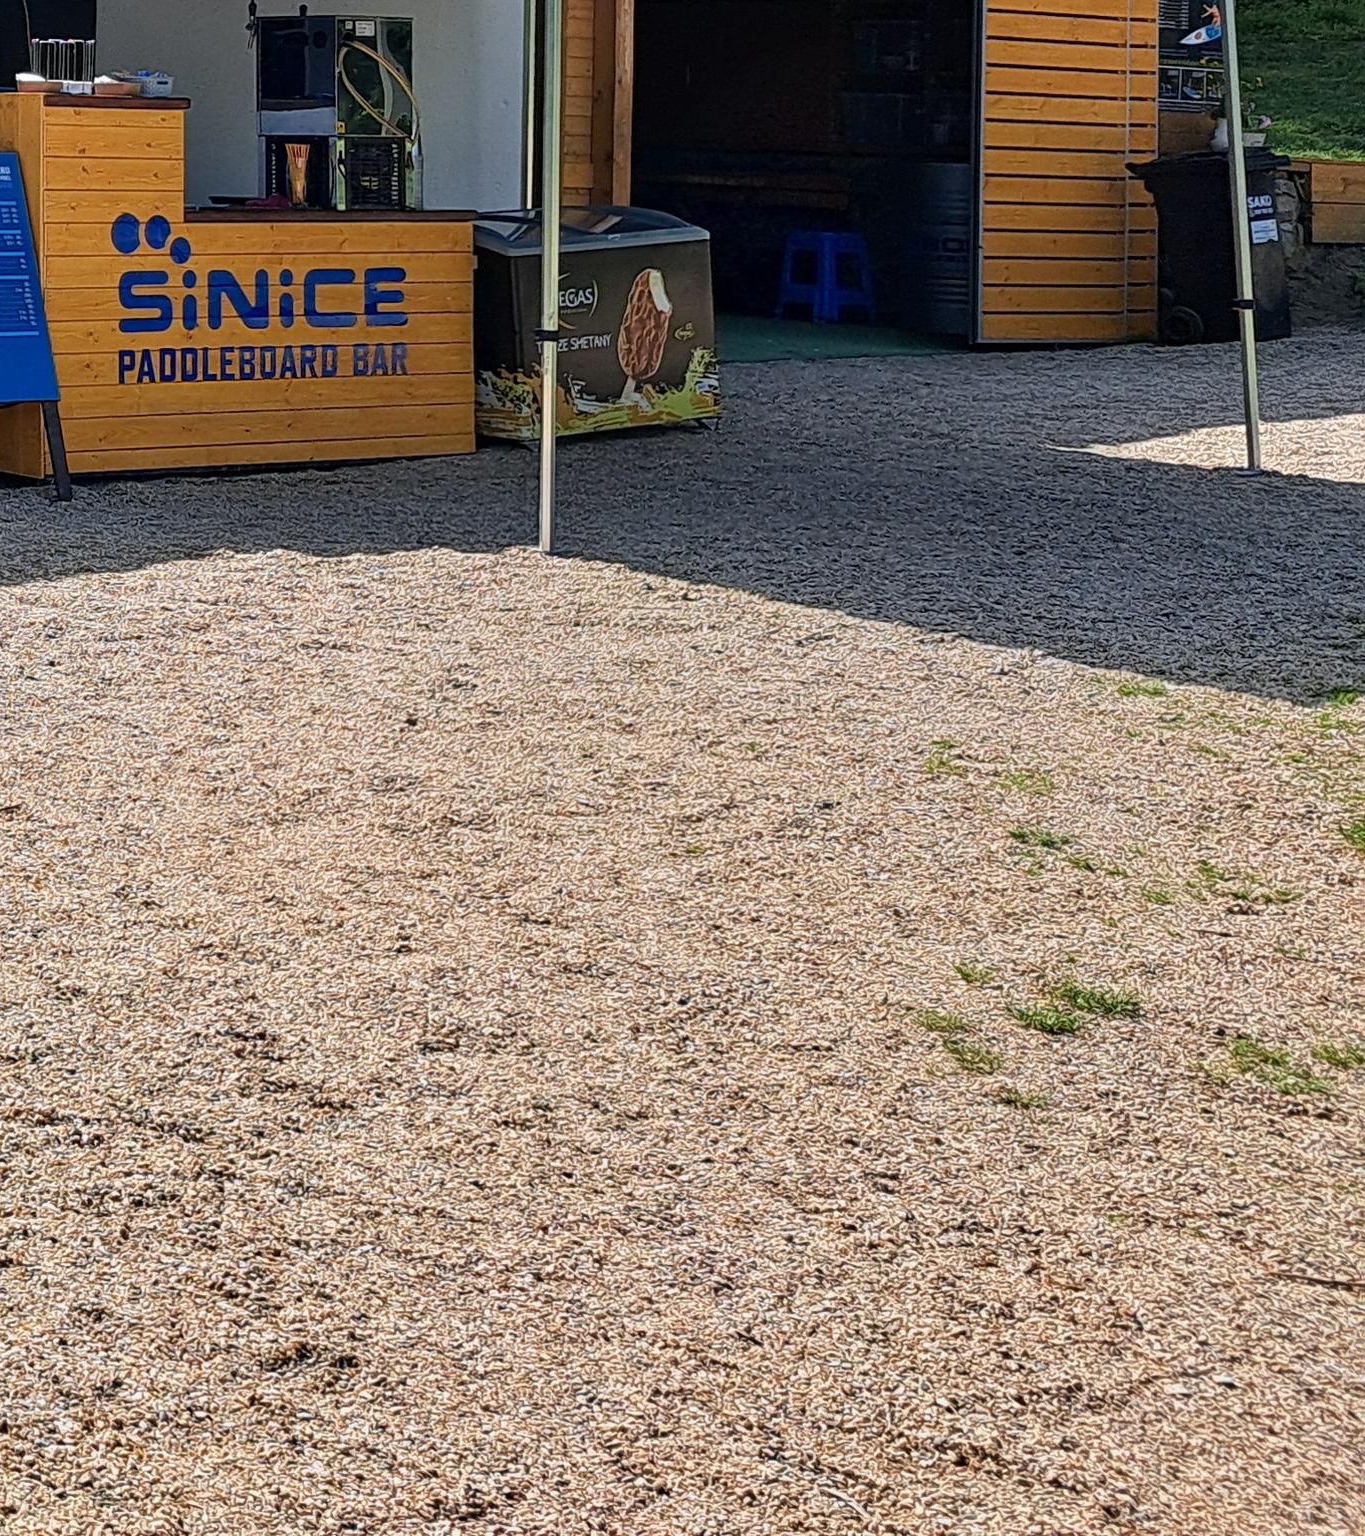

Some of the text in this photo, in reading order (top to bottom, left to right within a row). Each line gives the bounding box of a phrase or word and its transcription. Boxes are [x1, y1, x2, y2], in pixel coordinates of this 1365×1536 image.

[119, 267, 409, 333] SiNiCE
[118, 342, 408, 384] PADDLEBOARD BAR
[570, 334, 612, 351] SMETANY
